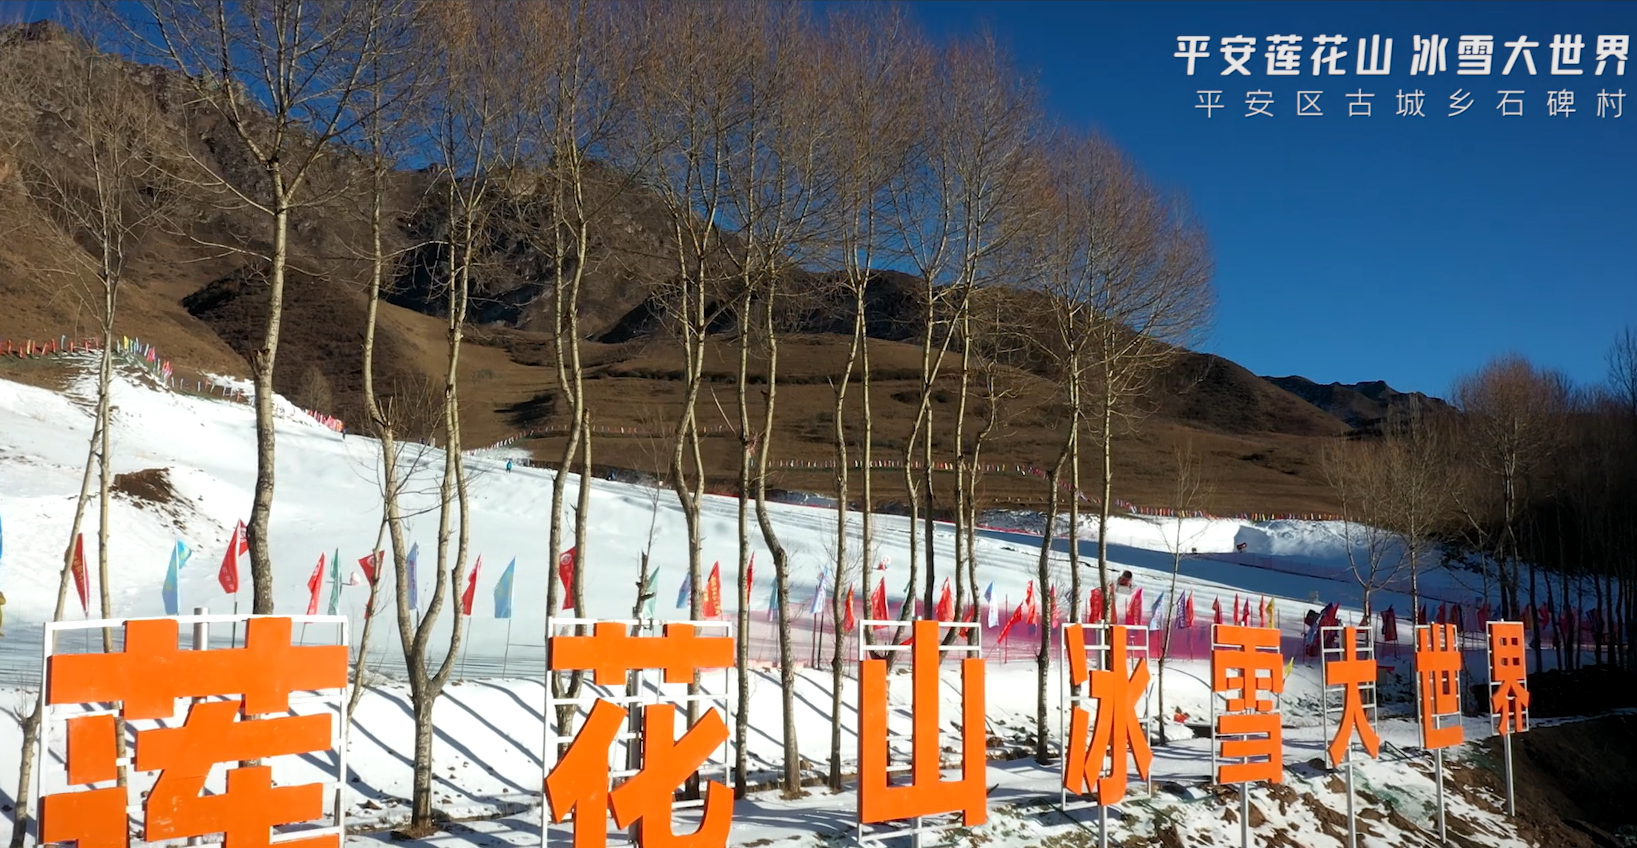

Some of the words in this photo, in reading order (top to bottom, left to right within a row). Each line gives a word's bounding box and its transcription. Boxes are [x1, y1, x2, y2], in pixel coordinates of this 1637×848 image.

[38, 617, 1530, 848] 莲花山冰雪大世界
